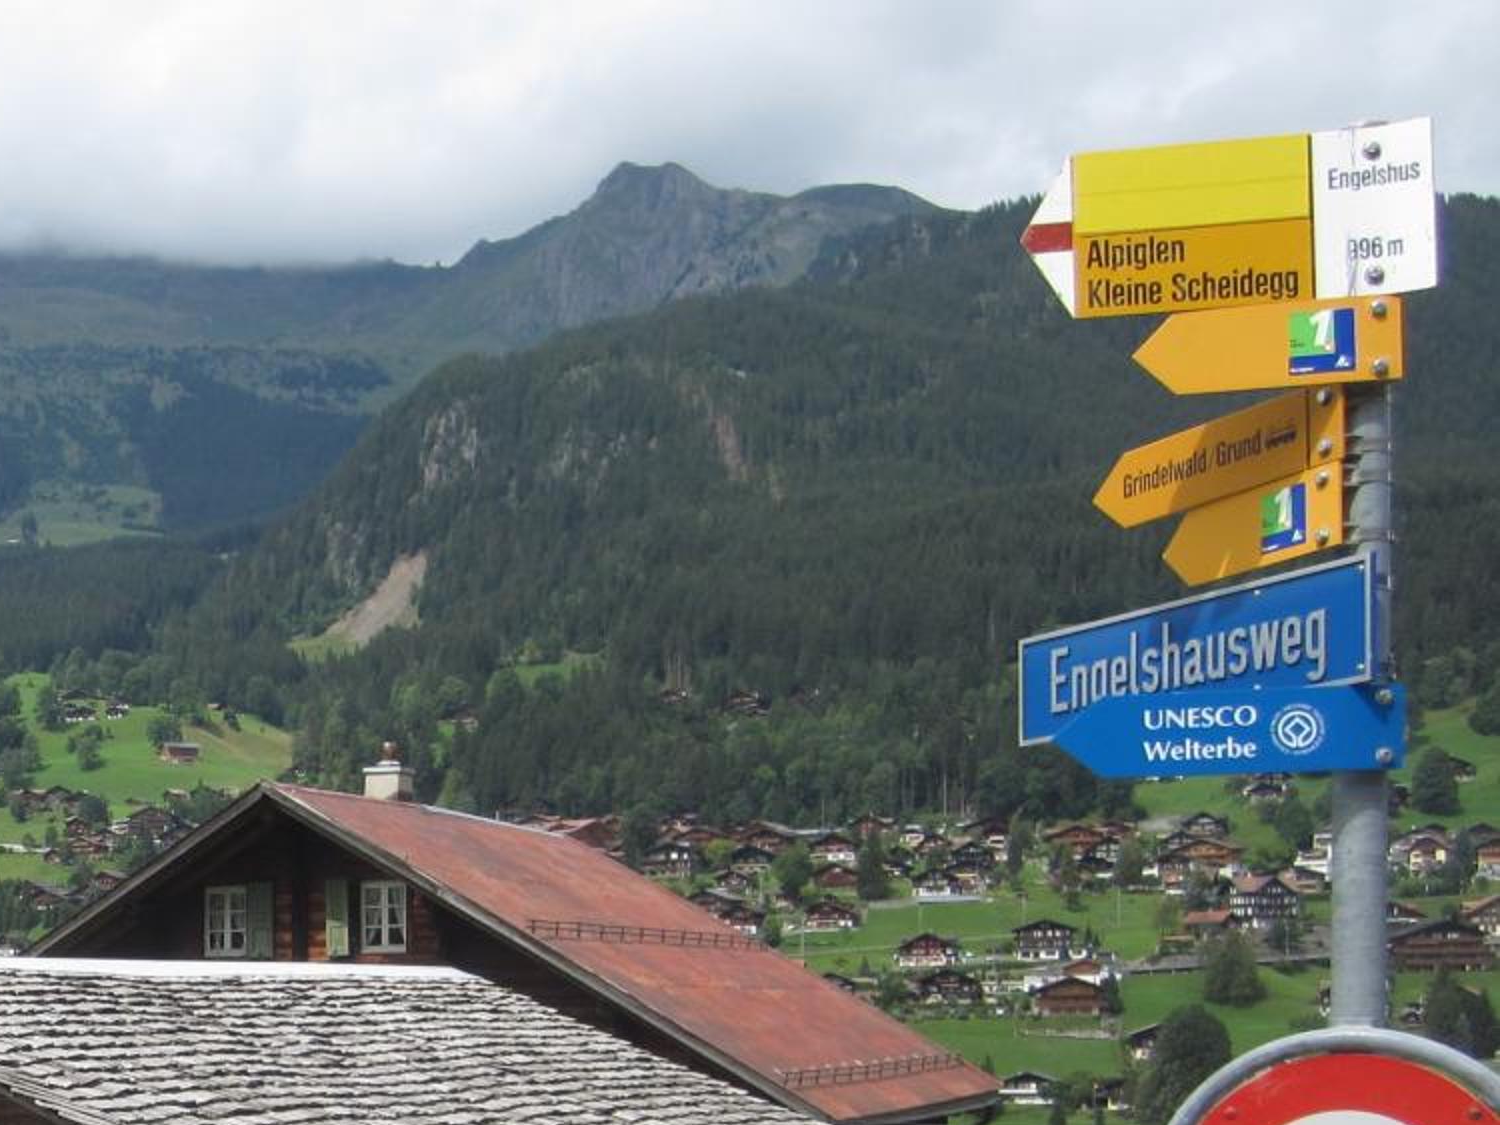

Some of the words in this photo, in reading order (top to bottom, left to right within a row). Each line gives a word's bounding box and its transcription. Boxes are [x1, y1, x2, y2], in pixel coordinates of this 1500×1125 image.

[1327, 161, 1421, 191] Engelshus
[1087, 236, 1185, 270] Alpiglen
[1387, 238, 1404, 257] m
[1088, 277, 1162, 308] Kleine
[1172, 268, 1299, 302] Scheidegg
[1143, 705, 1257, 730] UNESCO
[1143, 736, 1257, 761] Welterbe
